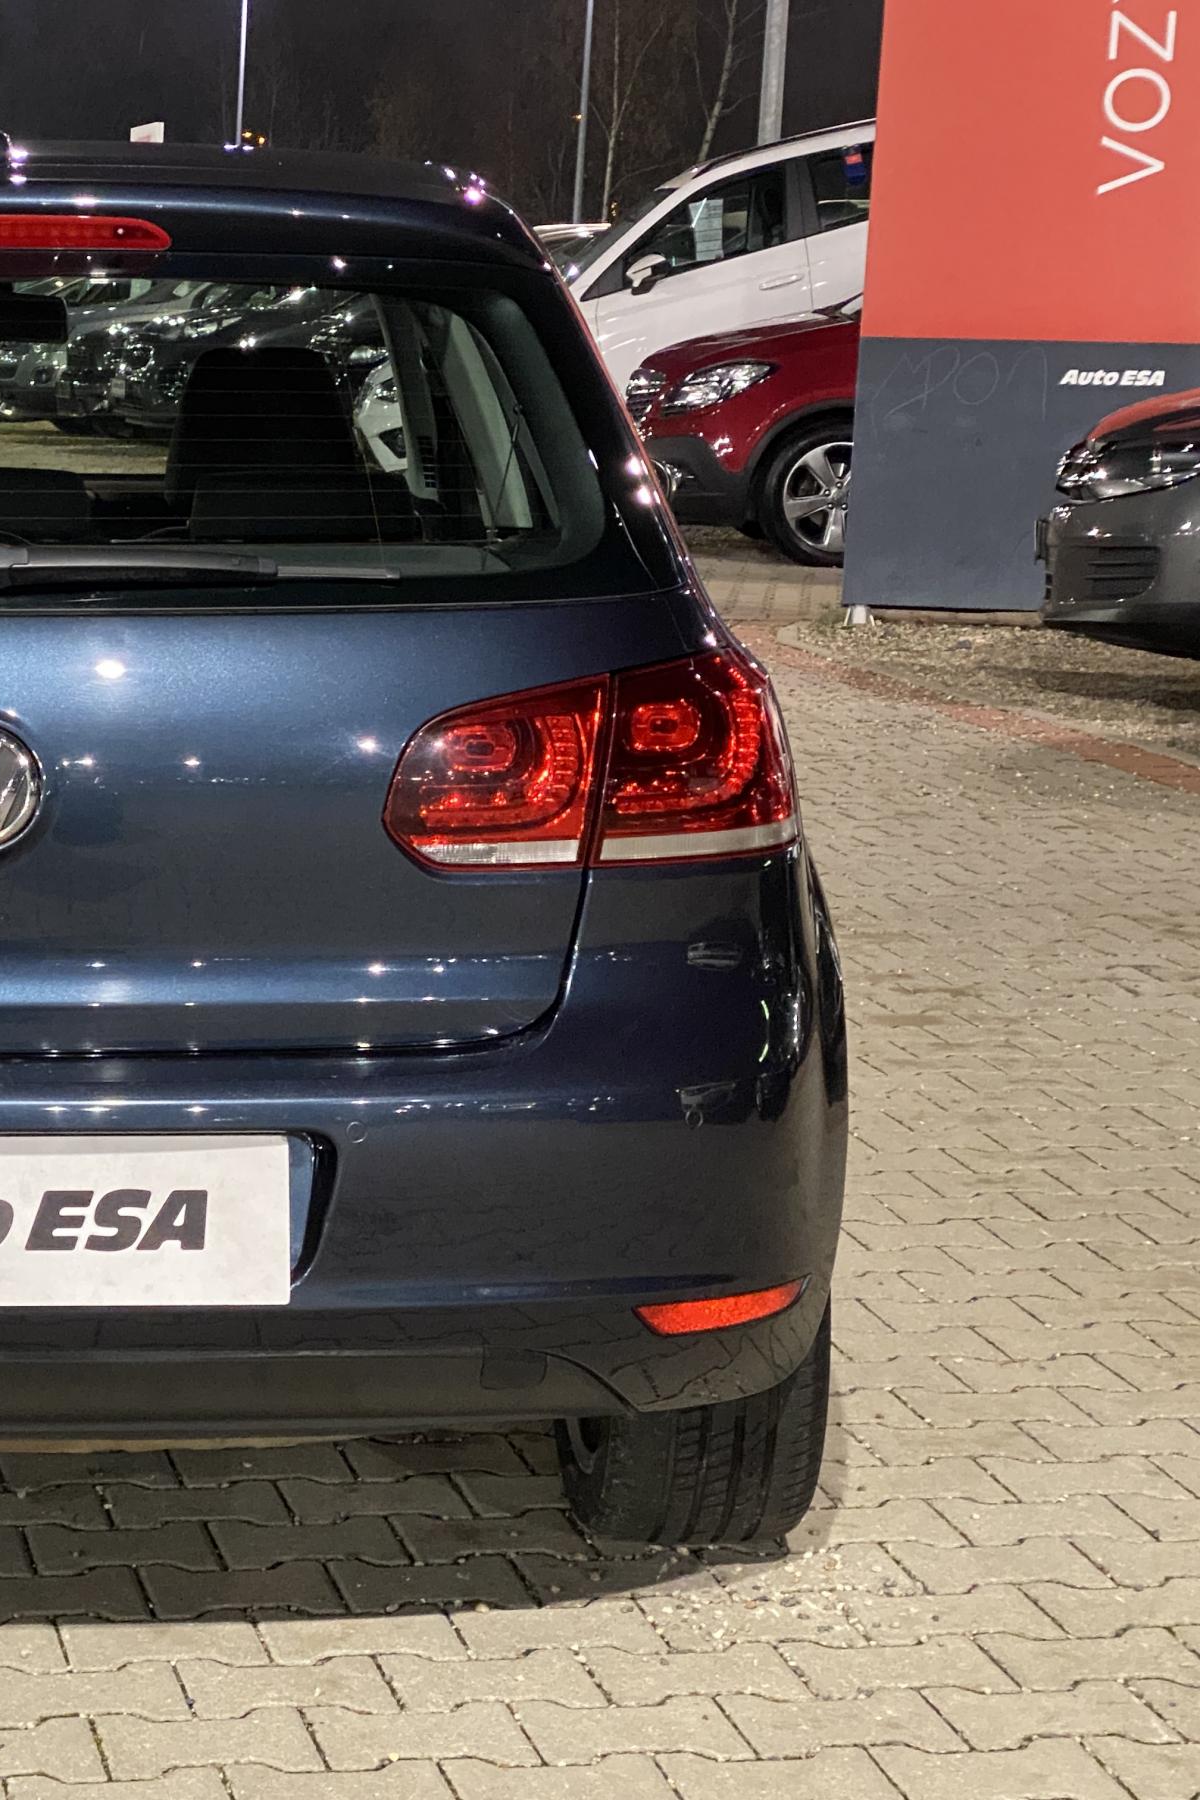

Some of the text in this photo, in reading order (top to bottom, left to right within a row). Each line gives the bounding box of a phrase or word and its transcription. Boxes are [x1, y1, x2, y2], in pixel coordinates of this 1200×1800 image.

[1096, 0, 1177, 195] VOZ
[1059, 369, 1166, 386] Auto ESA
[24, 1188, 208, 1252] ESA
